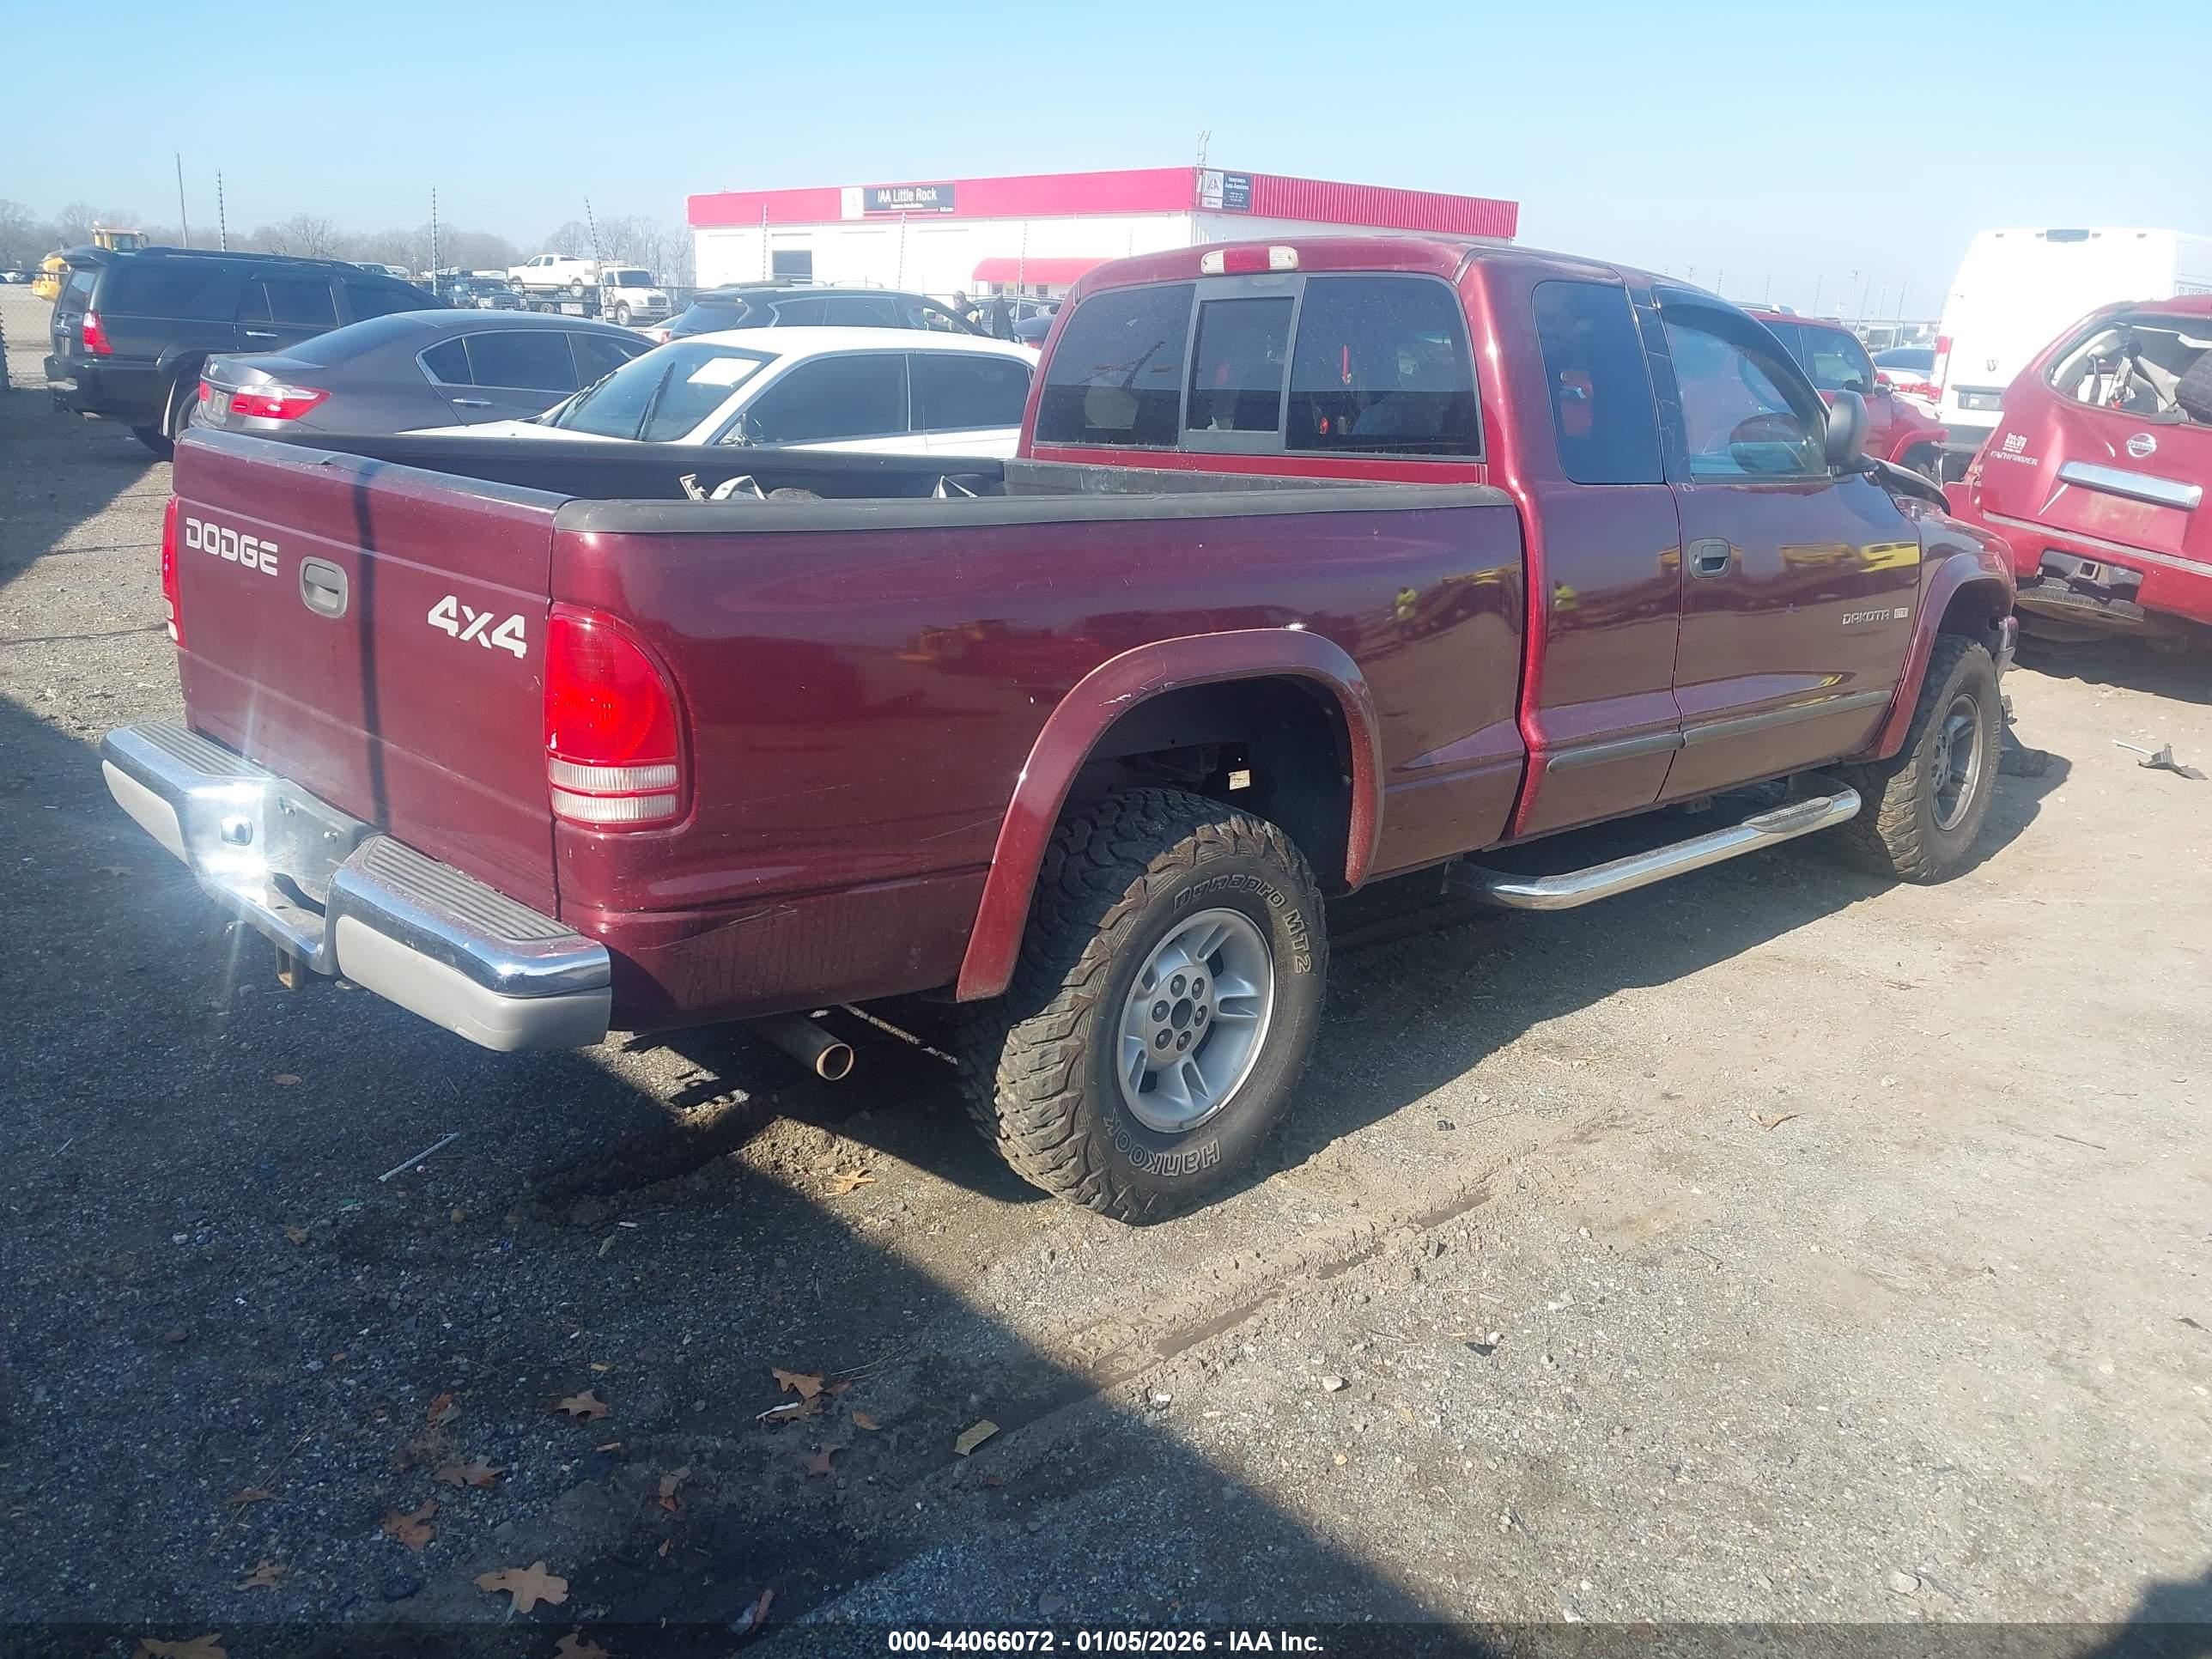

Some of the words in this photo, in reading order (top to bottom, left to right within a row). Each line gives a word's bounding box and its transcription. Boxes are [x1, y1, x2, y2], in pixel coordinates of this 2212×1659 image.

[878, 190, 891, 203] IAA
[893, 188, 914, 202] Little
[915, 187, 937, 201] Rock
[185, 517, 278, 576] DODGE
[1842, 609, 1890, 625] DAKOTA
